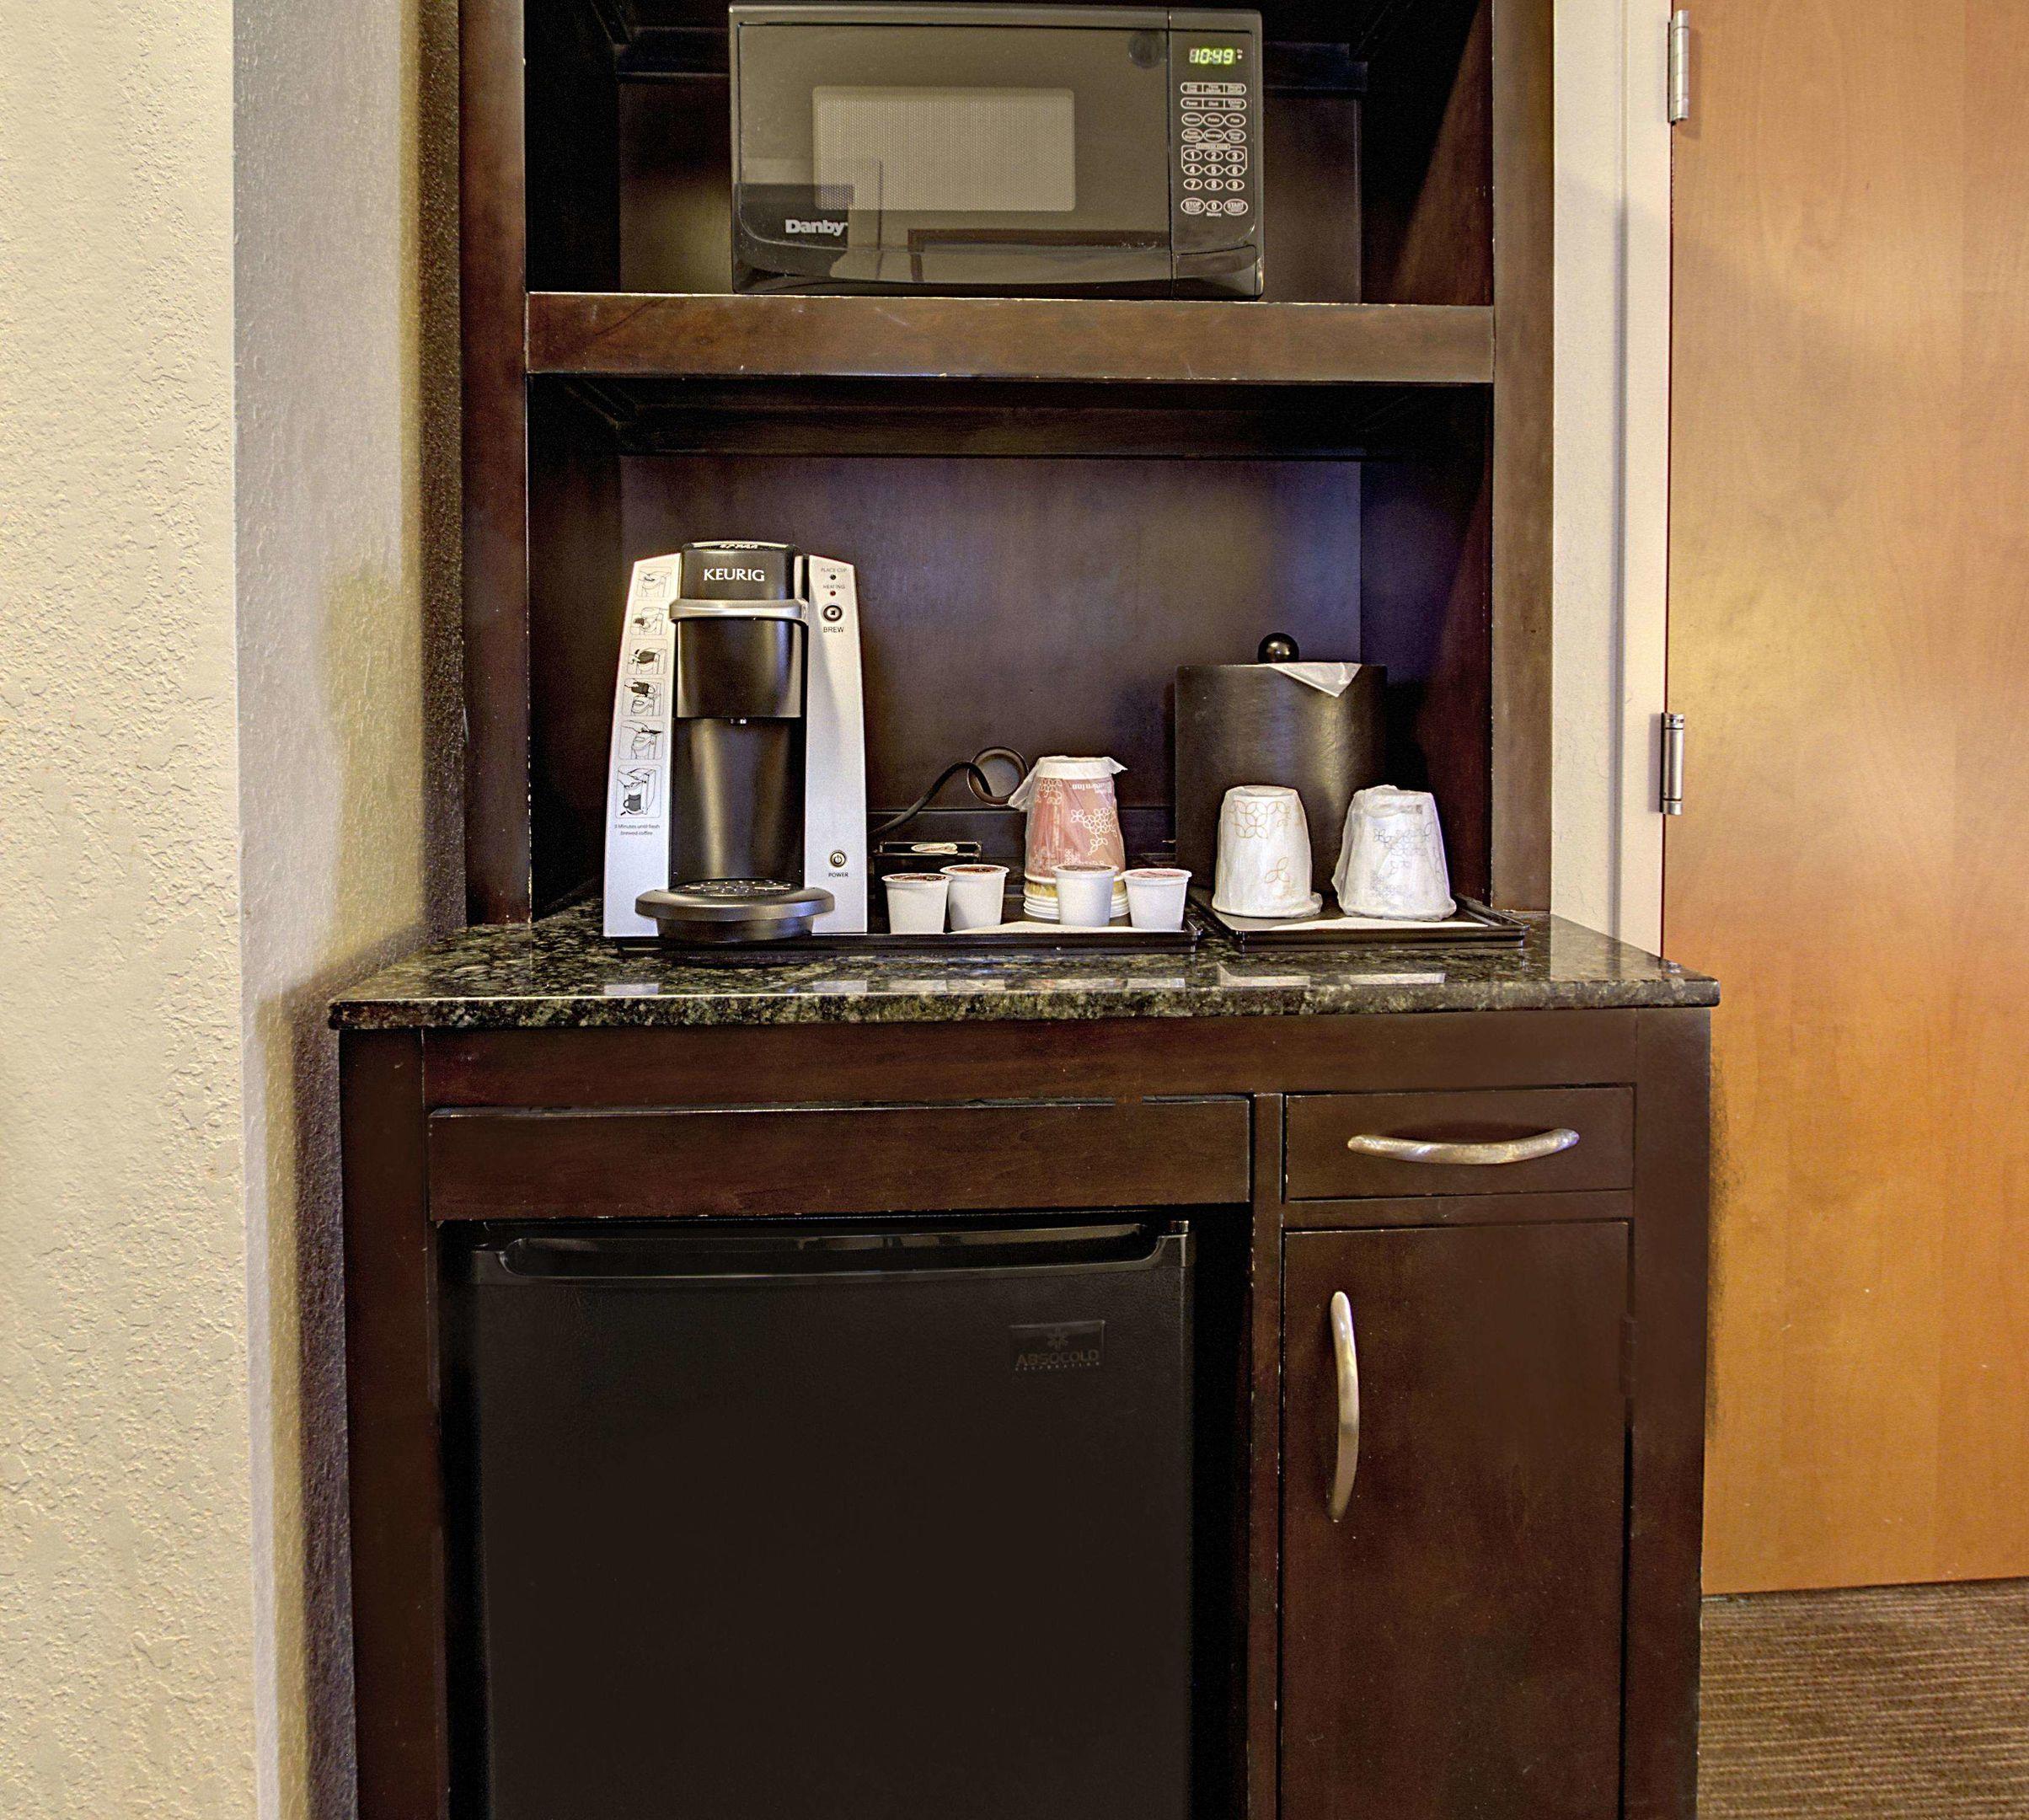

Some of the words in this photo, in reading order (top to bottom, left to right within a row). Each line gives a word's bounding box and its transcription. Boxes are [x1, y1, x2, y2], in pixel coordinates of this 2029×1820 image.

[1192, 48, 1234, 64] 10:49
[1190, 180, 1196, 189] 7
[1211, 180, 1217, 189] 8
[785, 219, 848, 236] Danby
[704, 568, 765, 581] KEURIG
[1016, 1349, 1100, 1366] ABSOCOLD
